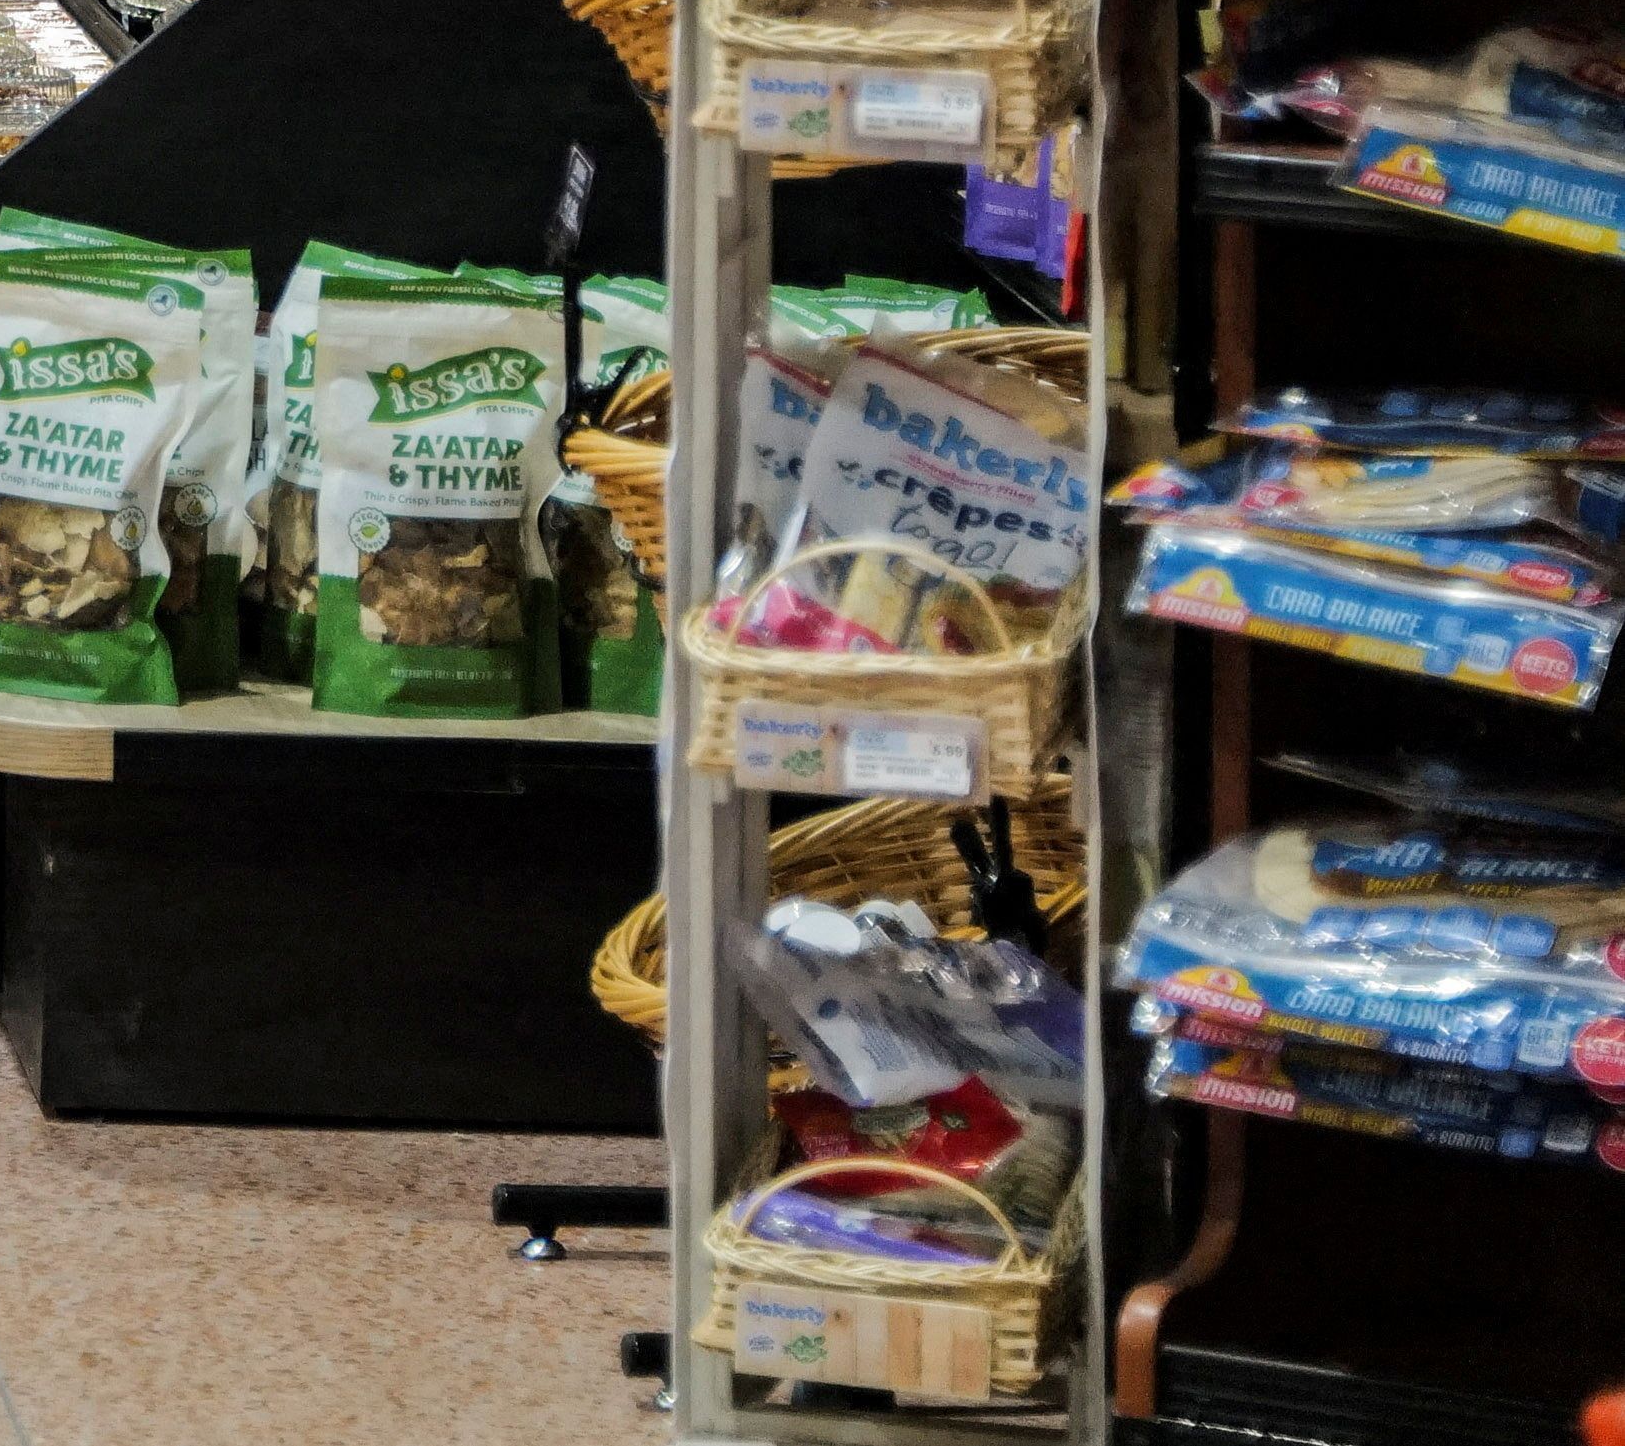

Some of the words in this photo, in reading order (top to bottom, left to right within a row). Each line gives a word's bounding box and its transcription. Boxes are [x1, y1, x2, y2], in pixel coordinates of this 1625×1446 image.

[1368, 173, 1446, 204] mission
[1467, 160, 1525, 198] CARB
[1526, 173, 1619, 220] BALANCE
[63, 232, 88, 245] MADE
[45, 253, 70, 262] MADE
[71, 253, 94, 262] WITH
[96, 253, 124, 261] FRESH
[125, 253, 152, 263] LOCAL
[153, 255, 186, 265] GRAINS
[8, 266, 30, 276] MADE
[30, 269, 54, 279] WITH
[55, 272, 81, 283] FRESH
[82, 275, 109, 287] LOCAL
[110, 279, 141, 291] GRAINS
[389, 284, 415, 294] MADE
[416, 284, 442, 294] WITH
[443, 284, 471, 295] FRESH
[8, 340, 139, 392] issa's
[387, 351, 527, 416] issa's
[89, 395, 114, 406] PITA
[115, 394, 145, 409] CHIPS
[475, 405, 500, 417] PITA
[500, 404, 536, 418] CHIPS
[4, 411, 126, 455] ZA'ATAR
[391, 433, 526, 461] ZA'ATAR
[863, 381, 1090, 514] bakerly
[17, 443, 126, 484] THYME
[177, 466, 206, 478] Chips
[388, 463, 409, 489] &
[414, 465, 525, 492] THYME
[31, 475, 61, 492] Flame
[62, 481, 92, 497] Baked
[93, 485, 114, 498] Pita
[364, 489, 388, 503] Thin
[435, 494, 468, 508] Flame
[470, 496, 502, 508] Baked
[874, 466, 1055, 543] crêpes
[1157, 595, 1246, 632] mission
[1266, 583, 1325, 617] CARB
[1327, 597, 1423, 640] BALANCE
[743, 715, 823, 739] bakerly
[1164, 983, 1264, 1019] mission
[1288, 989, 1354, 1020] CARB
[1409, 1039, 1468, 1065] BURRITO
[1198, 1078, 1296, 1111] mission
[1437, 1131, 1495, 1152] BURRITO
[745, 1297, 827, 1325] bakerly
